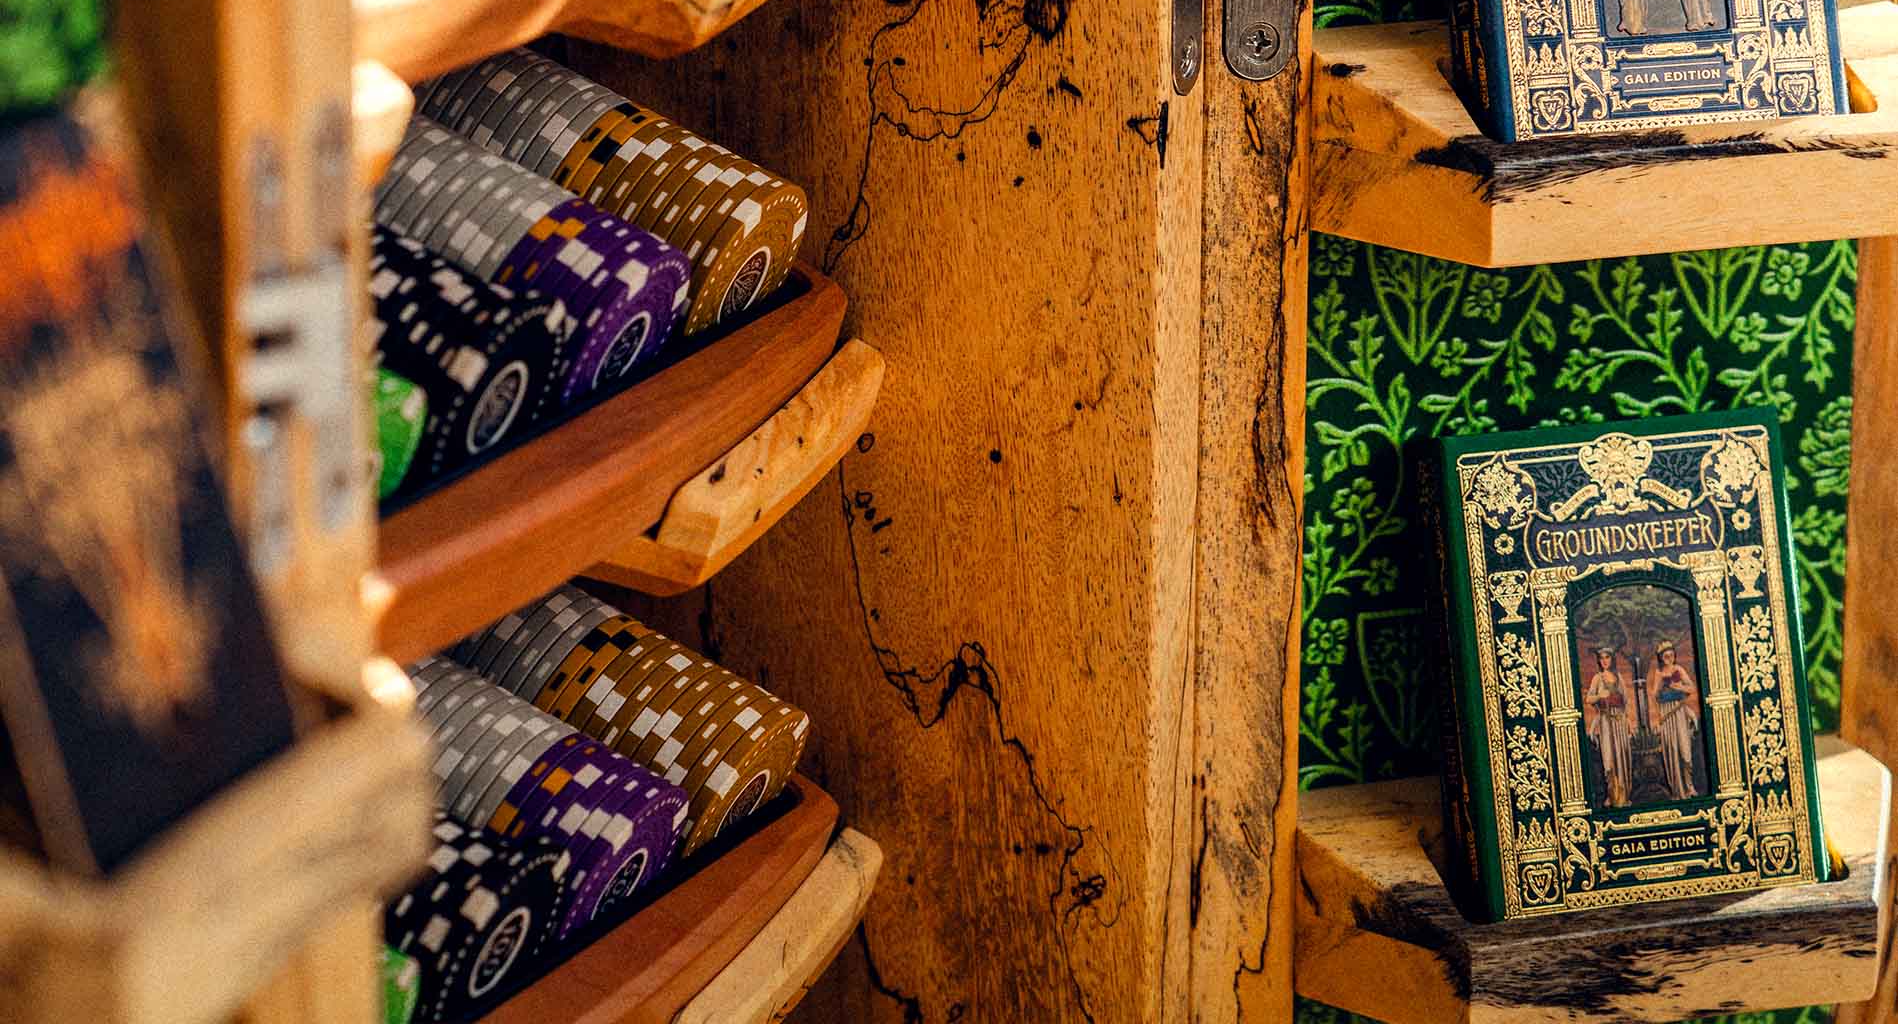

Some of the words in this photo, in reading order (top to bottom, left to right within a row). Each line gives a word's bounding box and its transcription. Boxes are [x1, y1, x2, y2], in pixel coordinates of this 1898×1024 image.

[1624, 73, 1660, 85] GAIA
[1664, 68, 1721, 82] EDITION
[1536, 509, 1719, 563] GROUNDSKEEPER
[1611, 841, 1646, 855] GAIA
[1650, 834, 1705, 851] EDITION
